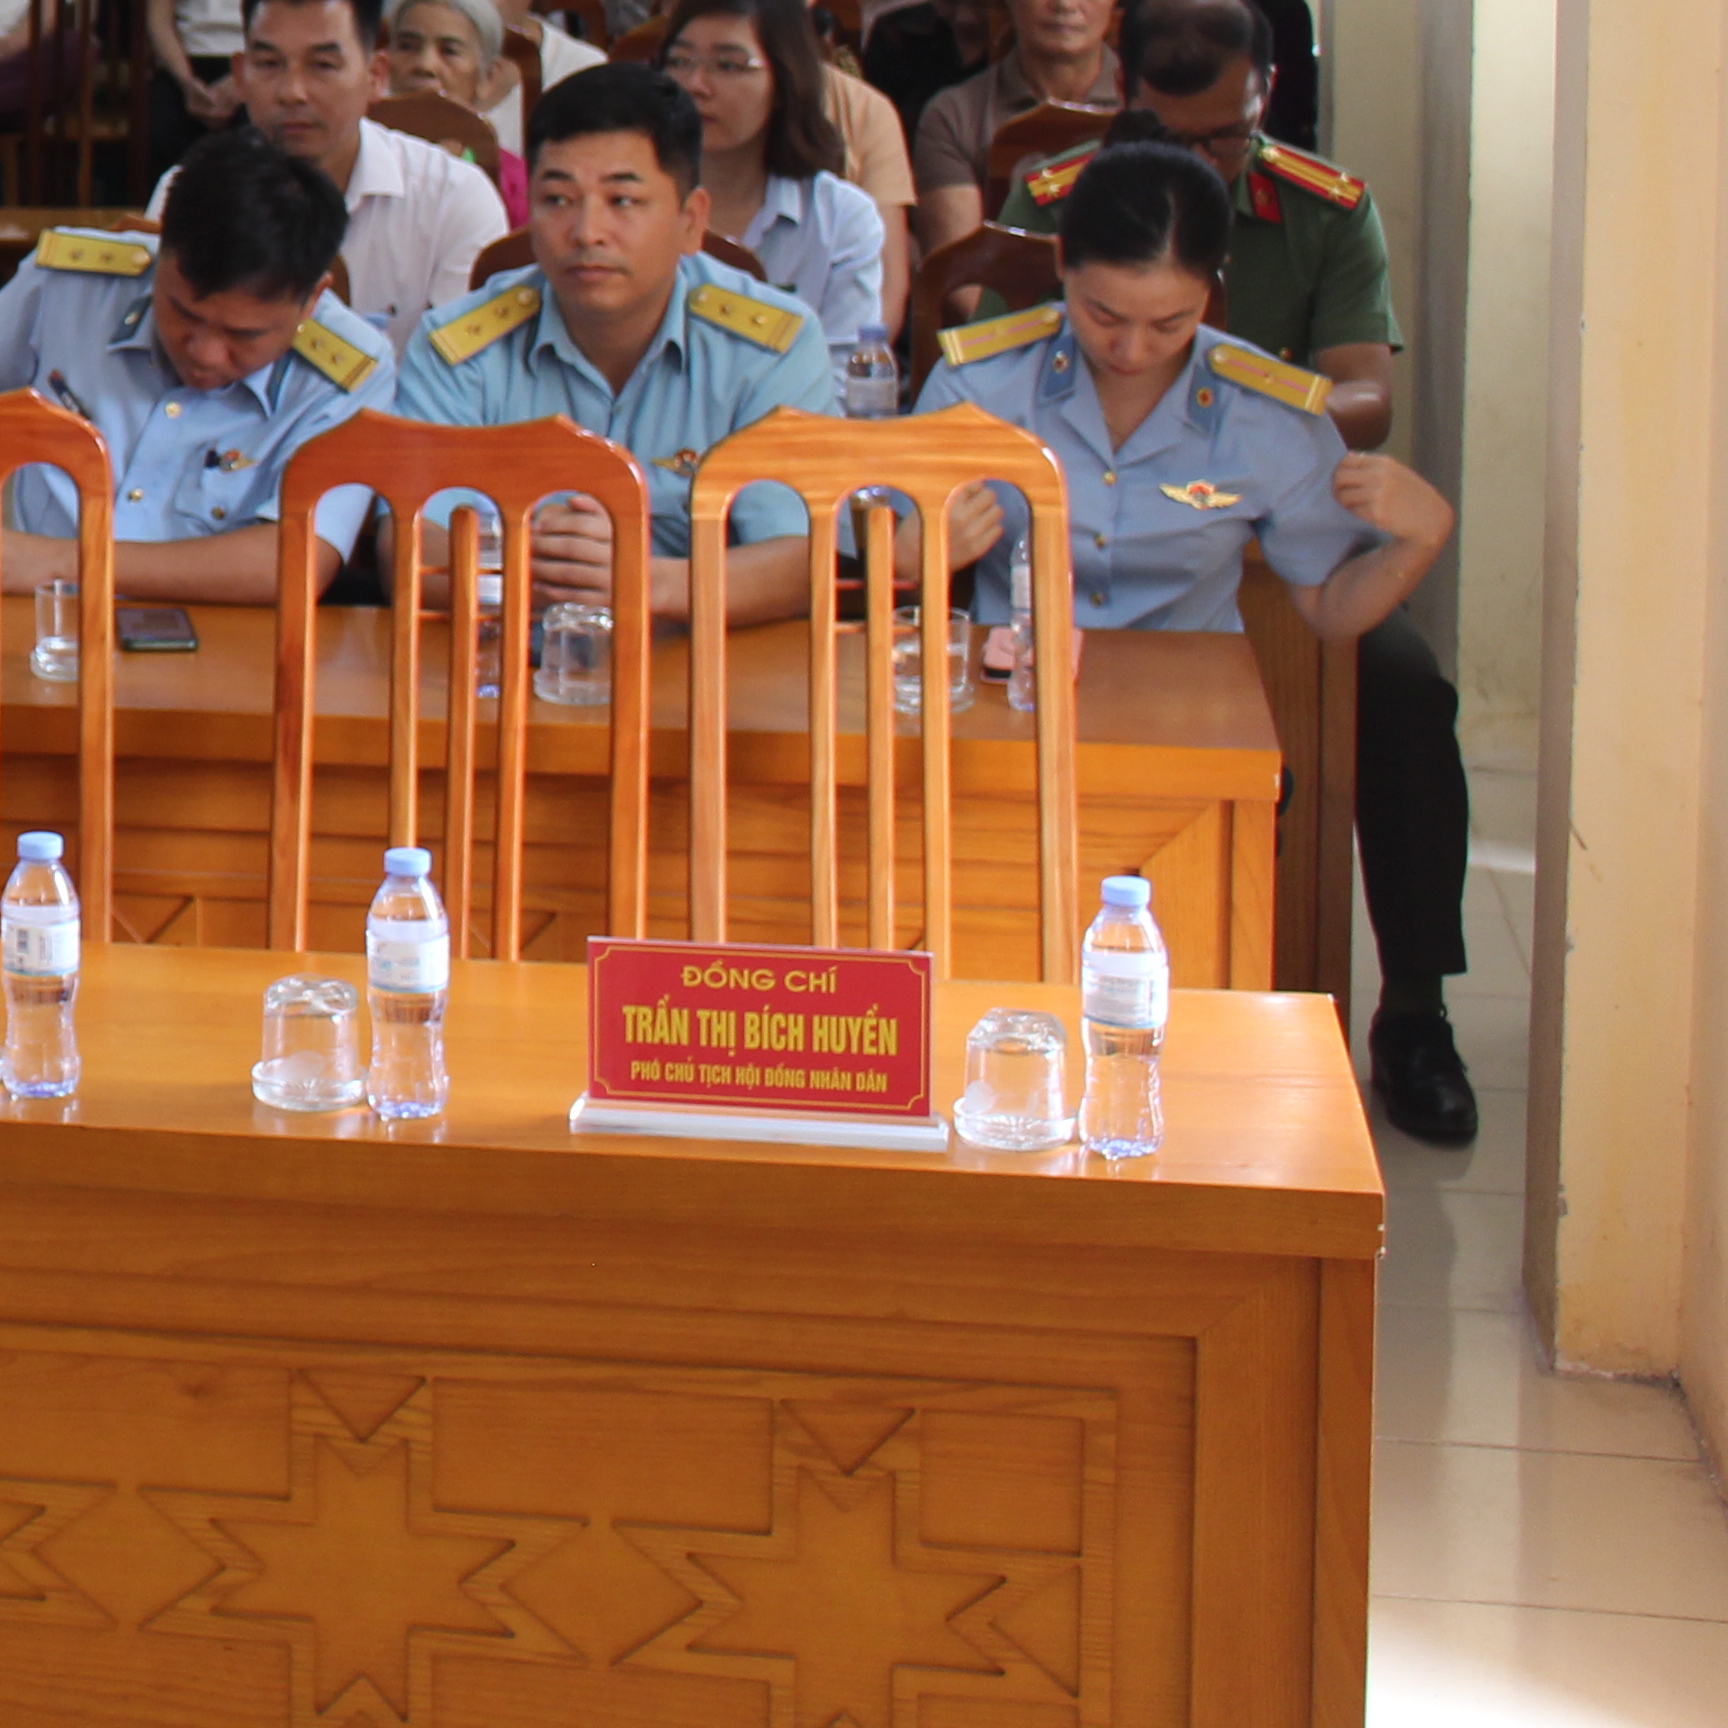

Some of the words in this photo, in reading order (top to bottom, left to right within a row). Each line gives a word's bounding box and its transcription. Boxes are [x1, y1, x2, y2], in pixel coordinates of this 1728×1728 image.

[680, 959, 776, 991] ĐỒNG
[784, 965, 838, 993] CHÍ
[622, 993, 689, 1046] TRẦN
[696, 1009, 736, 1057] THỊ
[744, 1003, 804, 1052] BÍCH
[812, 1003, 897, 1056] HUYỀN
[630, 1056, 661, 1081] PHÓ
[665, 1055, 695, 1084] CHỦ
[698, 1062, 731, 1088] TỊCH
[735, 1061, 760, 1090] HỘI
[764, 1061, 805, 1089] ĐỒNG
[809, 1066, 852, 1091] NHÂN
[855, 1068, 887, 1093] DÂN
